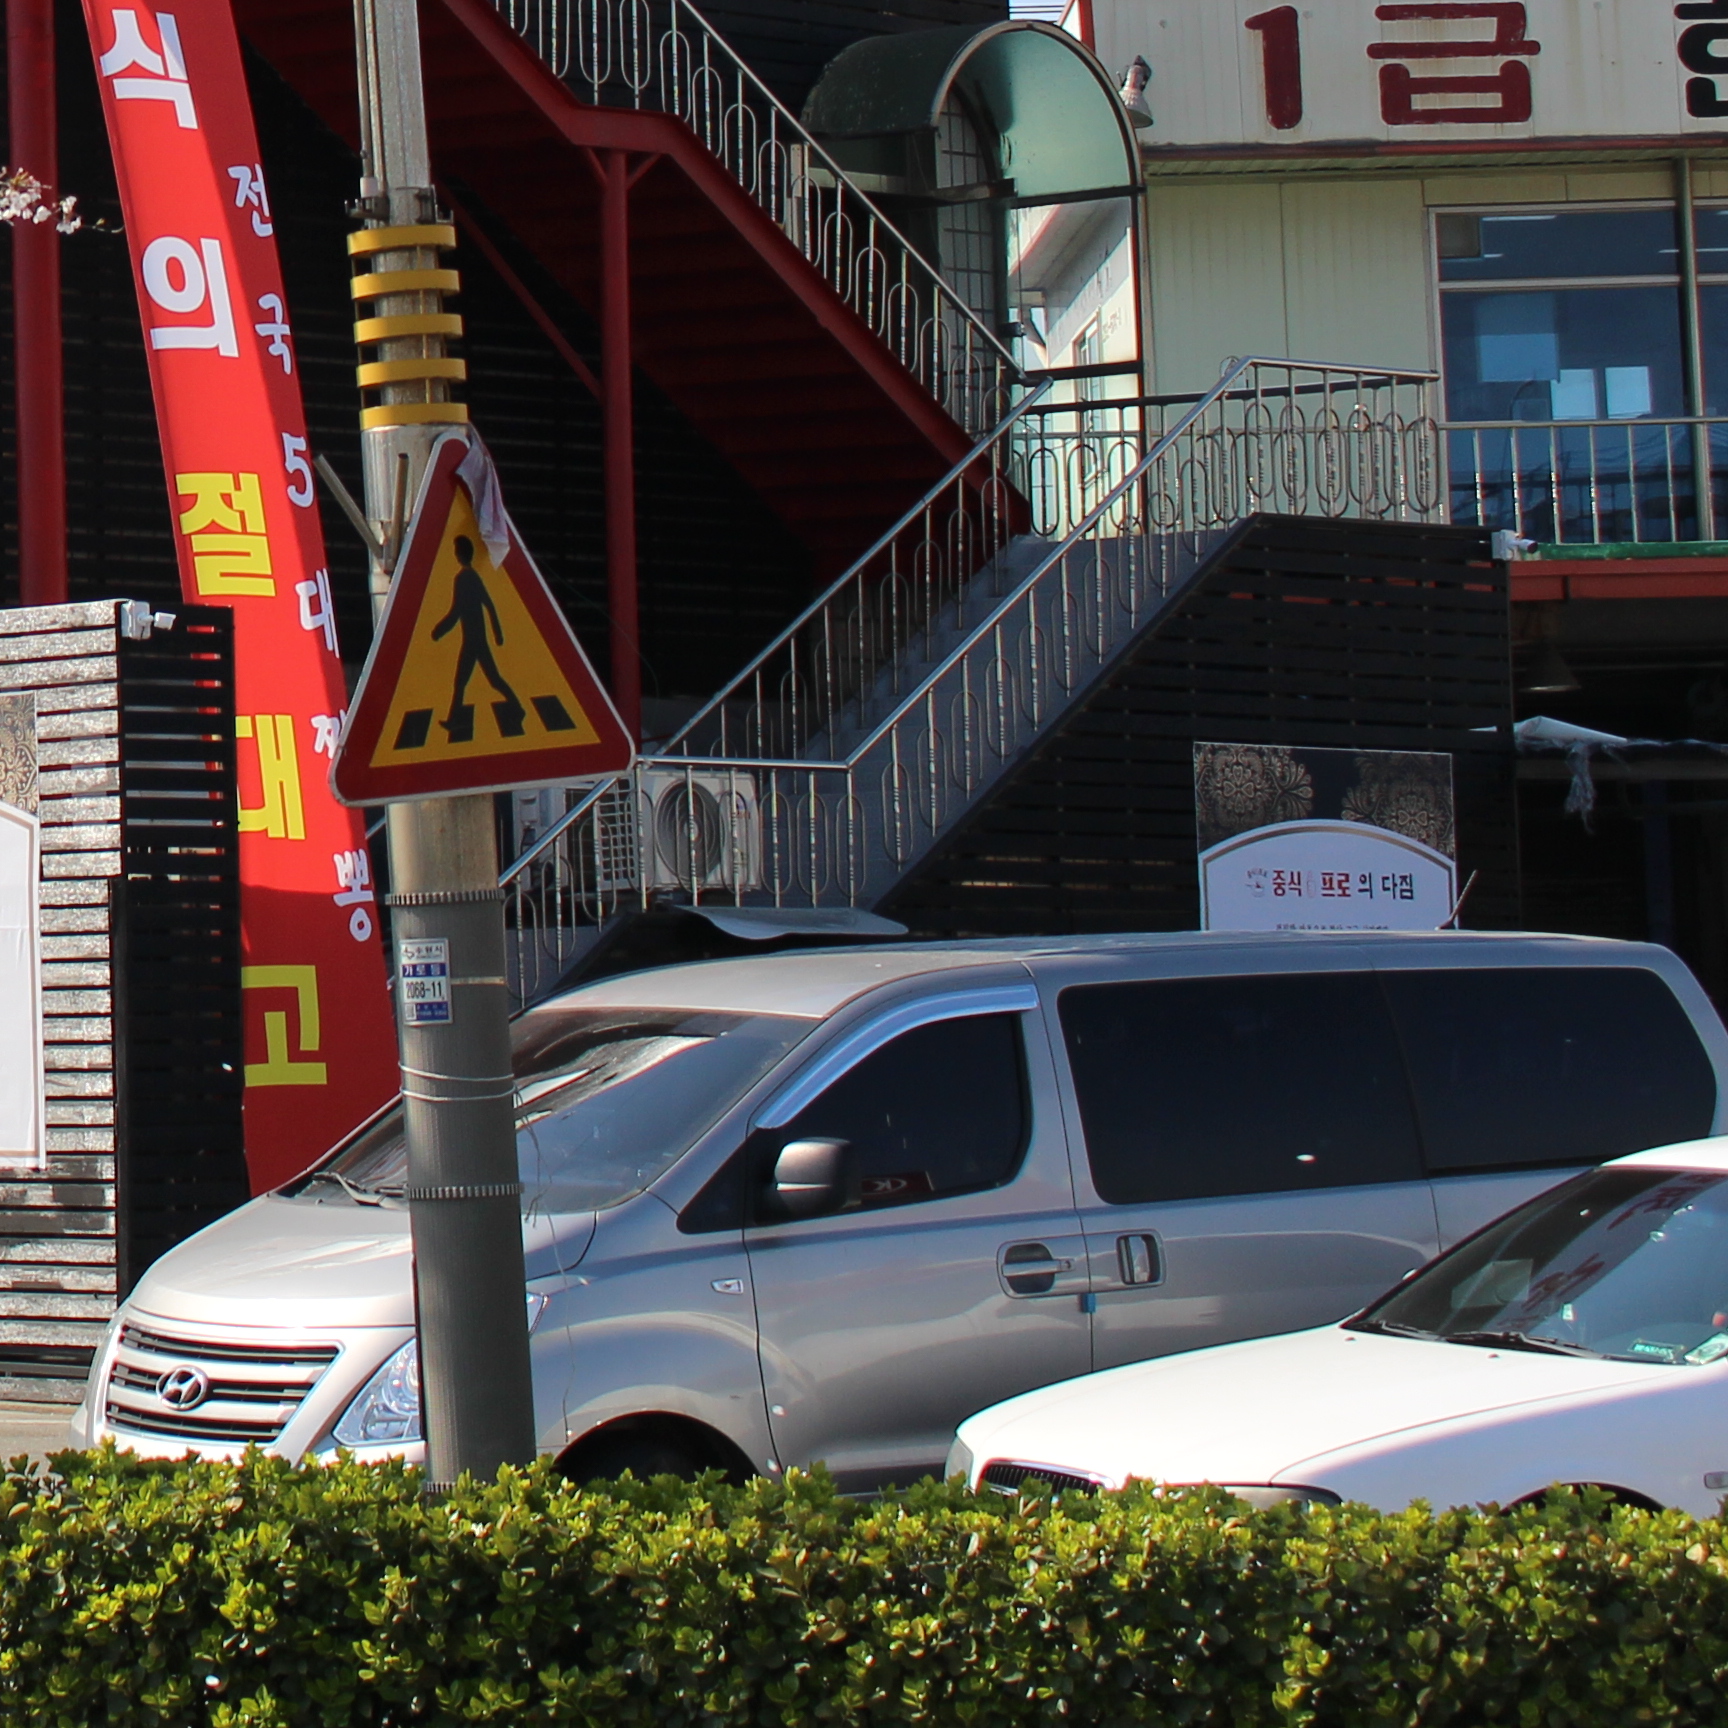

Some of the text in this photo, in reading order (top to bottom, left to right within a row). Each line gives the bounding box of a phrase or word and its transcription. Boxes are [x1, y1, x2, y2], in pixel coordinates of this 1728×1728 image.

[1244, 1, 1542, 130] 1급
[227, 162, 292, 376] 전국
[281, 431, 341, 660] 5대
[1272, 870, 1302, 897] 중식
[1320, 872, 1351, 897] 프로
[1357, 872, 1373, 899] 의
[1381, 873, 1414, 900] 다짐
